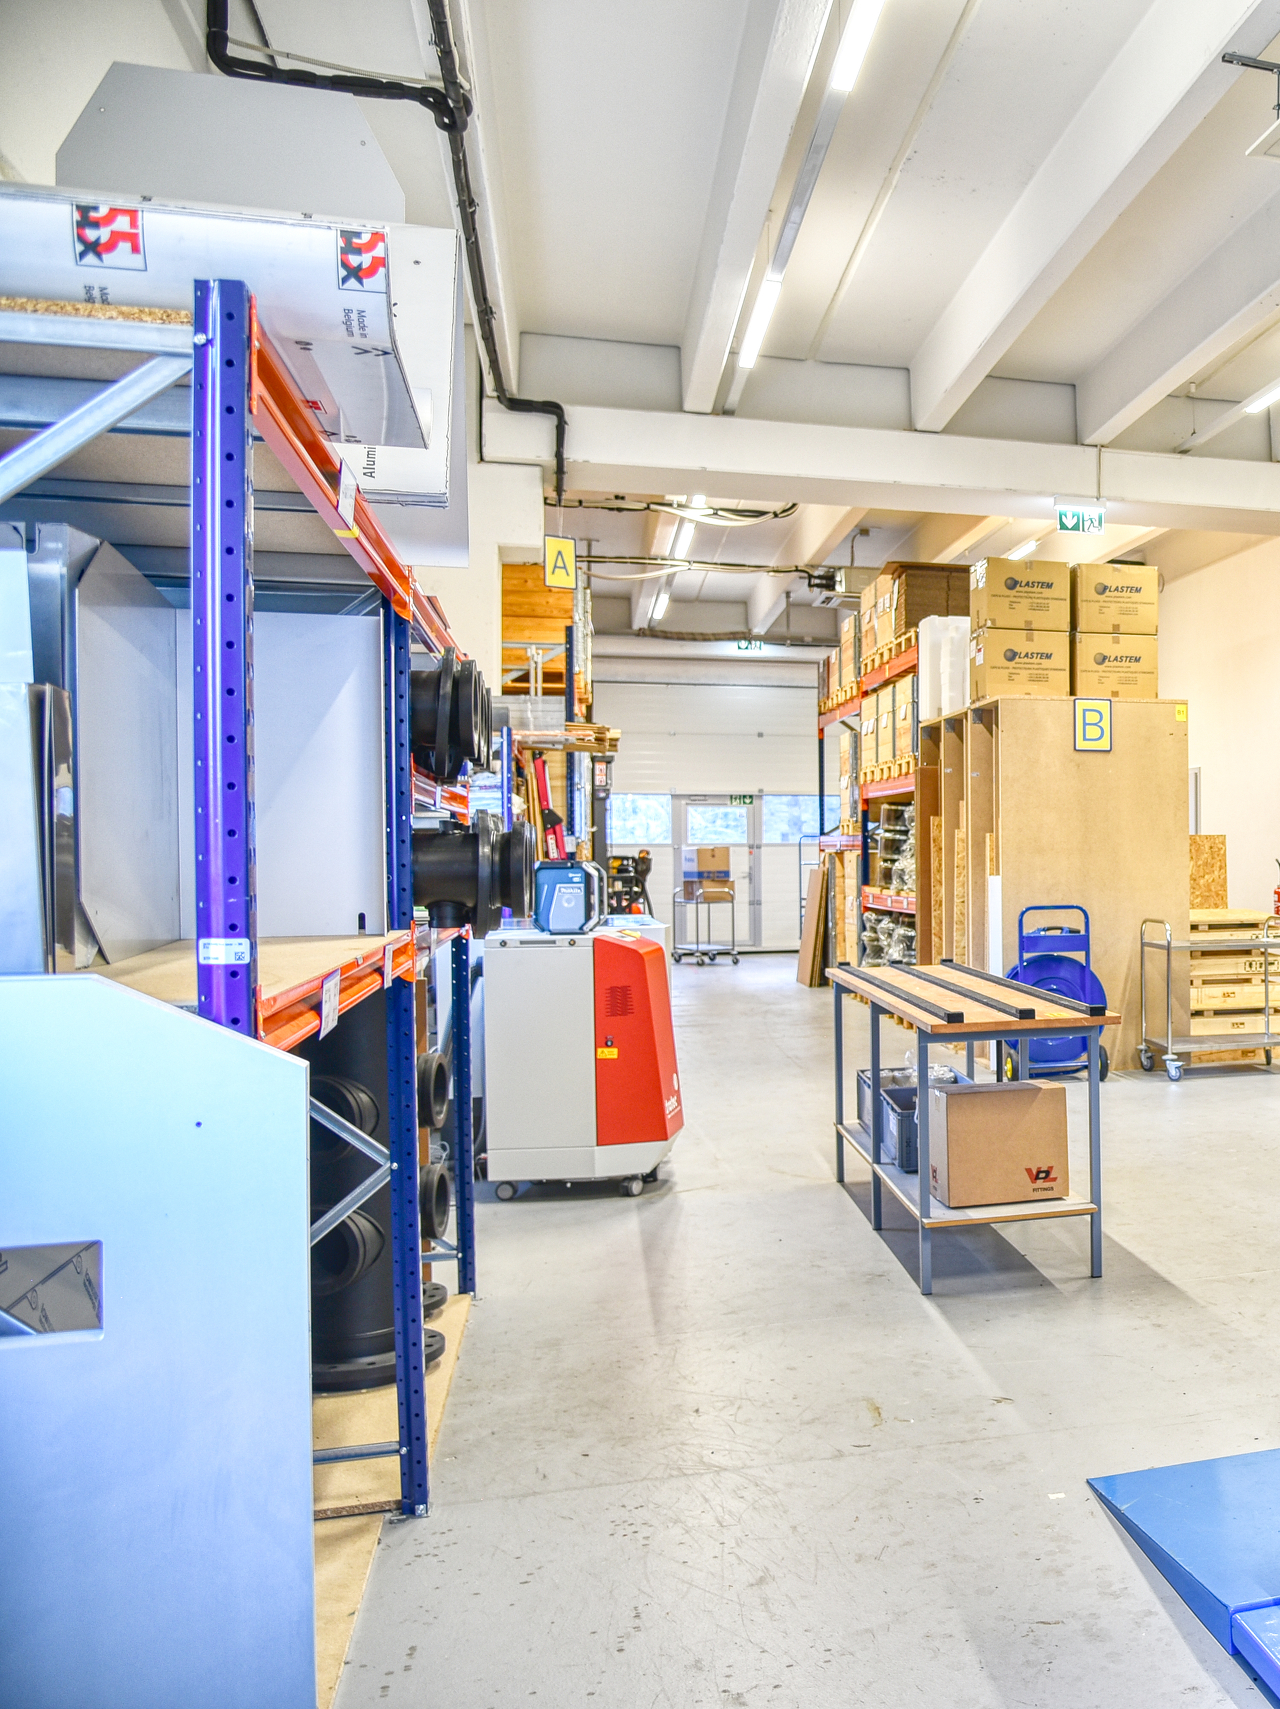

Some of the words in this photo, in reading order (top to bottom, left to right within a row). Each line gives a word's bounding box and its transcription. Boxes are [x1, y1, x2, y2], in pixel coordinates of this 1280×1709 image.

[343, 308, 354, 337] Belgium
[356, 309, 367, 330] Made
[363, 446, 377, 479] Alumi
[552, 550, 569, 577] A
[1014, 580, 1054, 590] PLASTEM
[1102, 585, 1142, 594] PLASTEM
[1013, 651, 1053, 660] PLASTEM
[1102, 655, 1142, 664] PLASTEM
[1083, 708, 1104, 742] B
[1024, 1166, 1058, 1184] VDL
